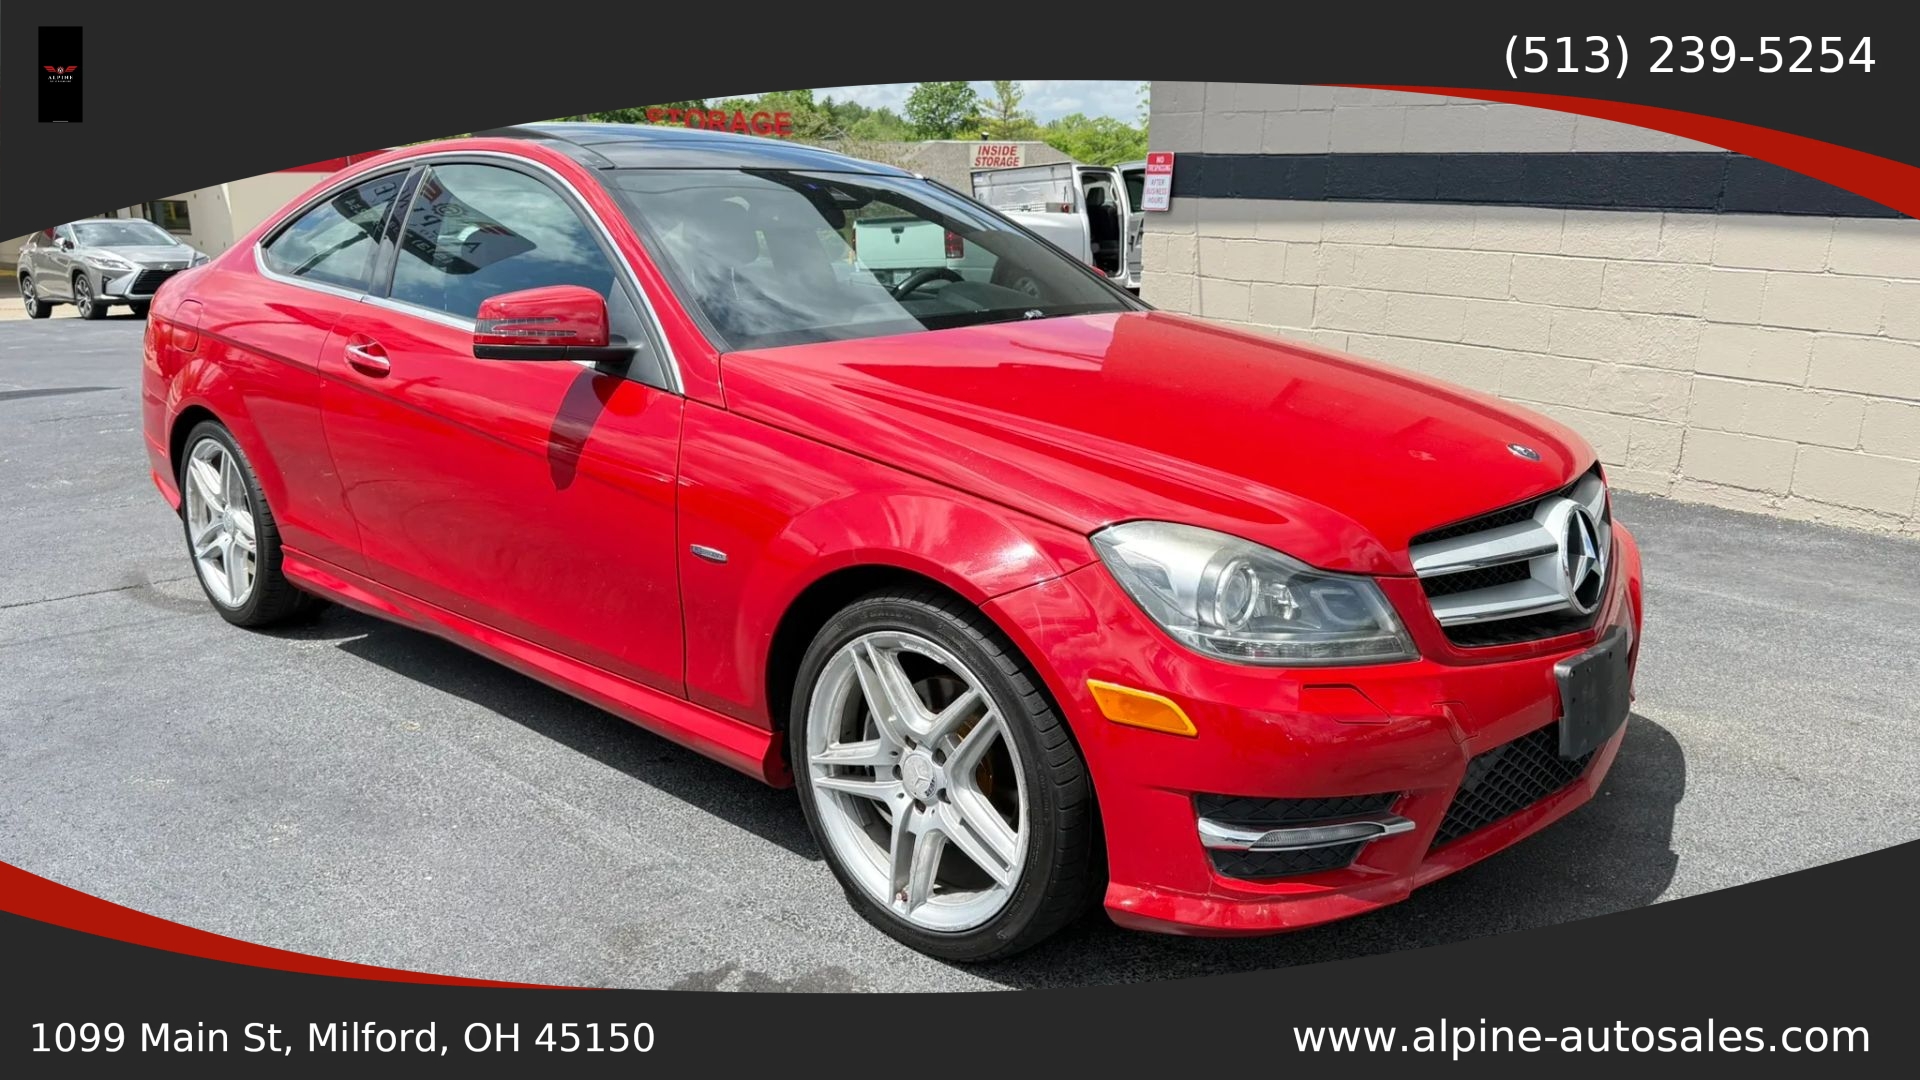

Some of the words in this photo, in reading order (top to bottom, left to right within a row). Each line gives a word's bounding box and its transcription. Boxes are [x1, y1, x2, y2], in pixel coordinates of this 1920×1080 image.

[646, 108, 794, 136] STORAGE
[978, 145, 1018, 156] INSIDE
[974, 156, 1020, 167] STORAGE
[1155, 155, 1165, 164] NO
